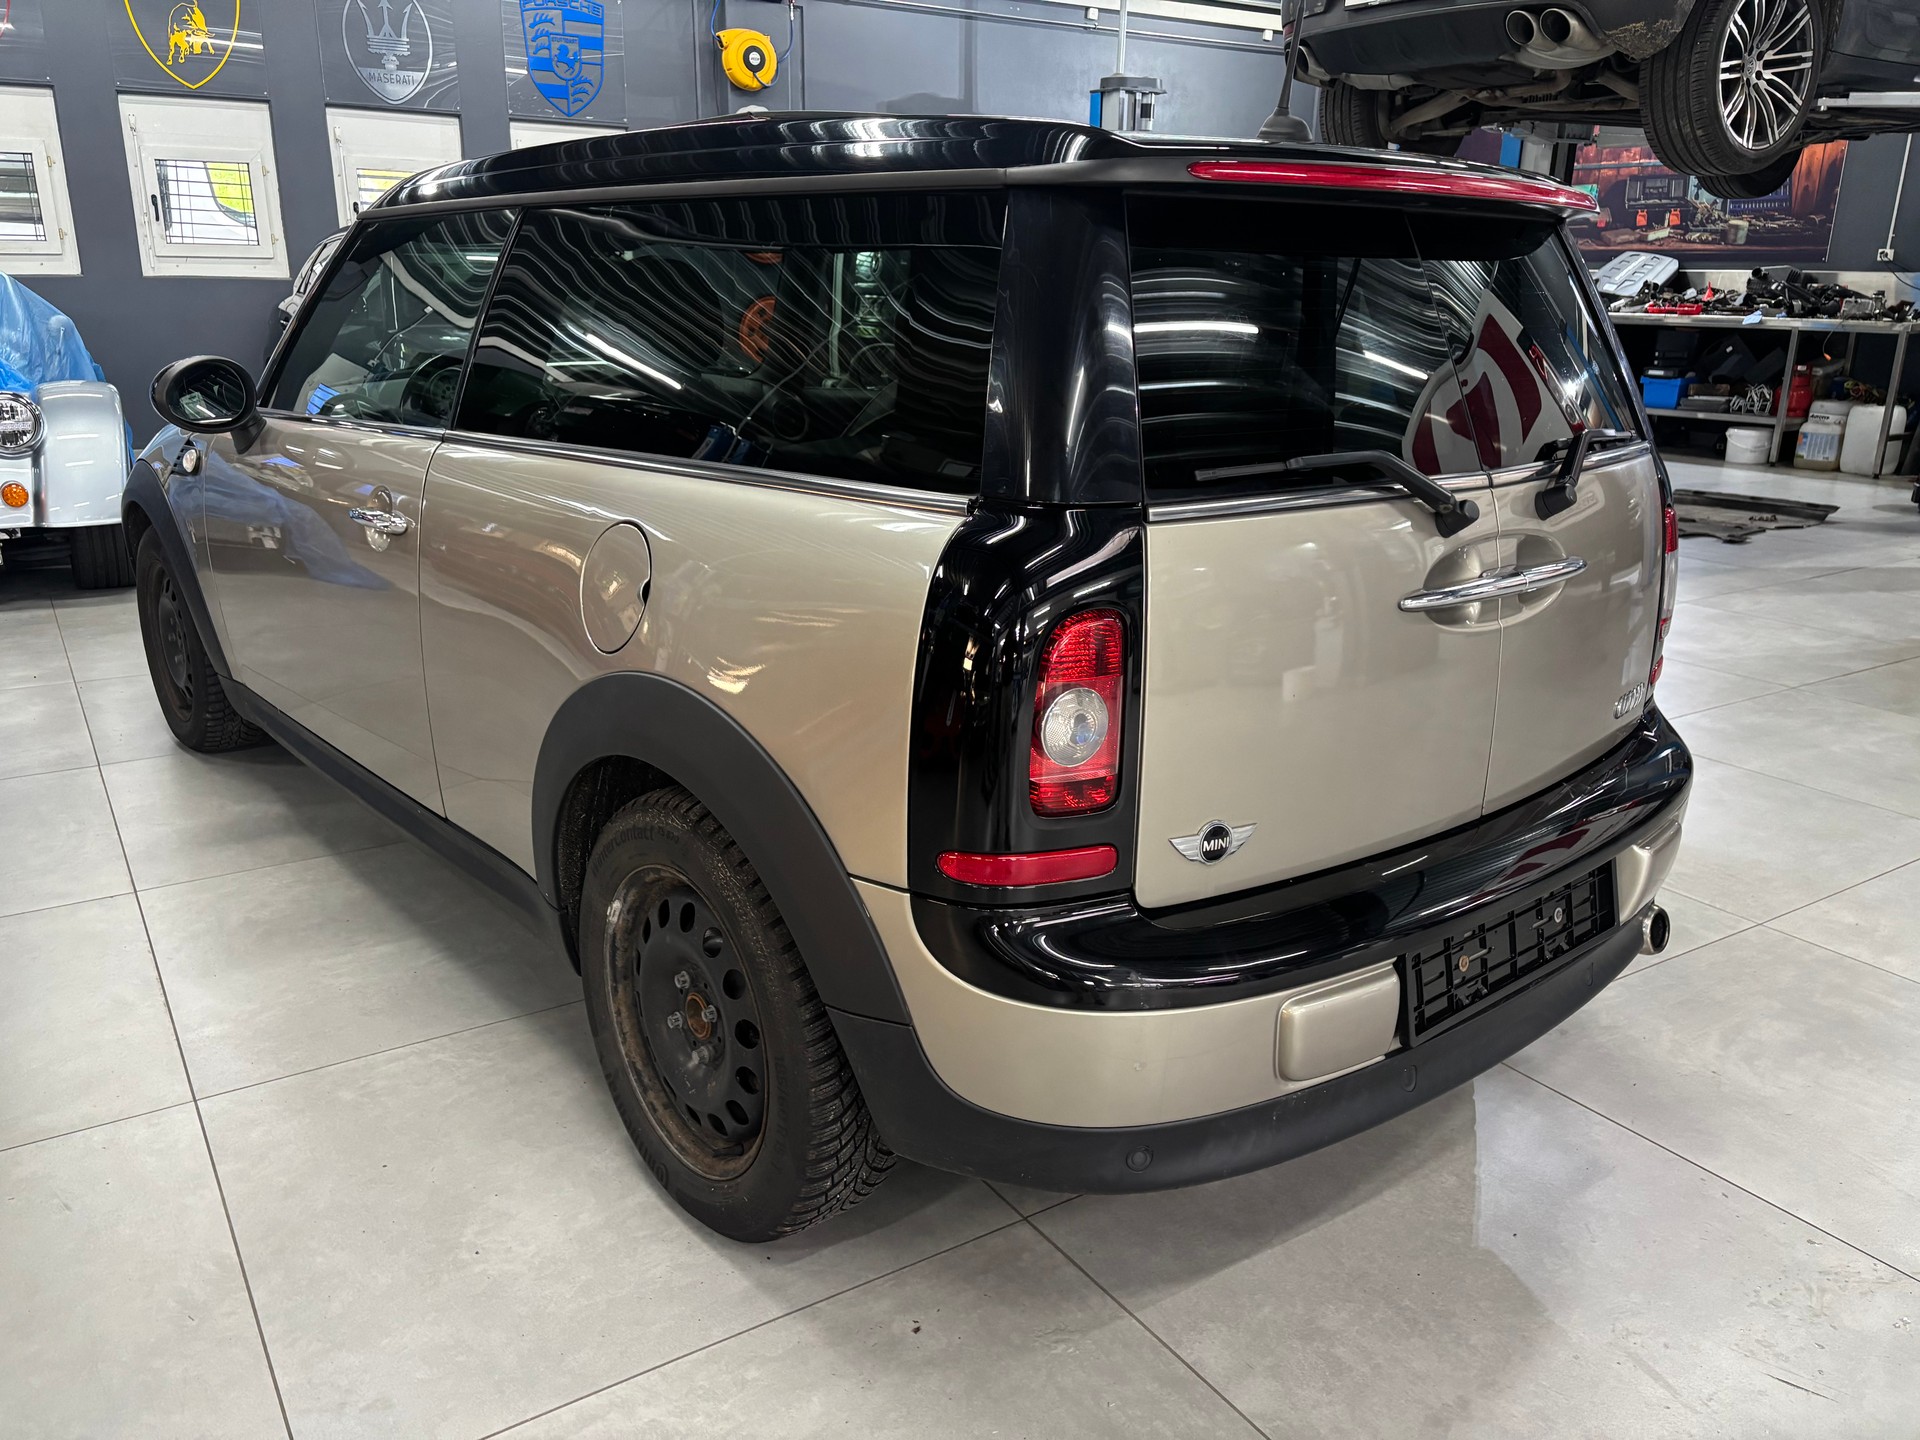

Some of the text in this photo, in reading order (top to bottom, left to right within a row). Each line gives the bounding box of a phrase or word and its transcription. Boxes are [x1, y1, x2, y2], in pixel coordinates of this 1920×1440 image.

[522, 0, 601, 17] PORSCHE
[368, 72, 415, 86] MASERATI
[1203, 836, 1230, 852] MINI
